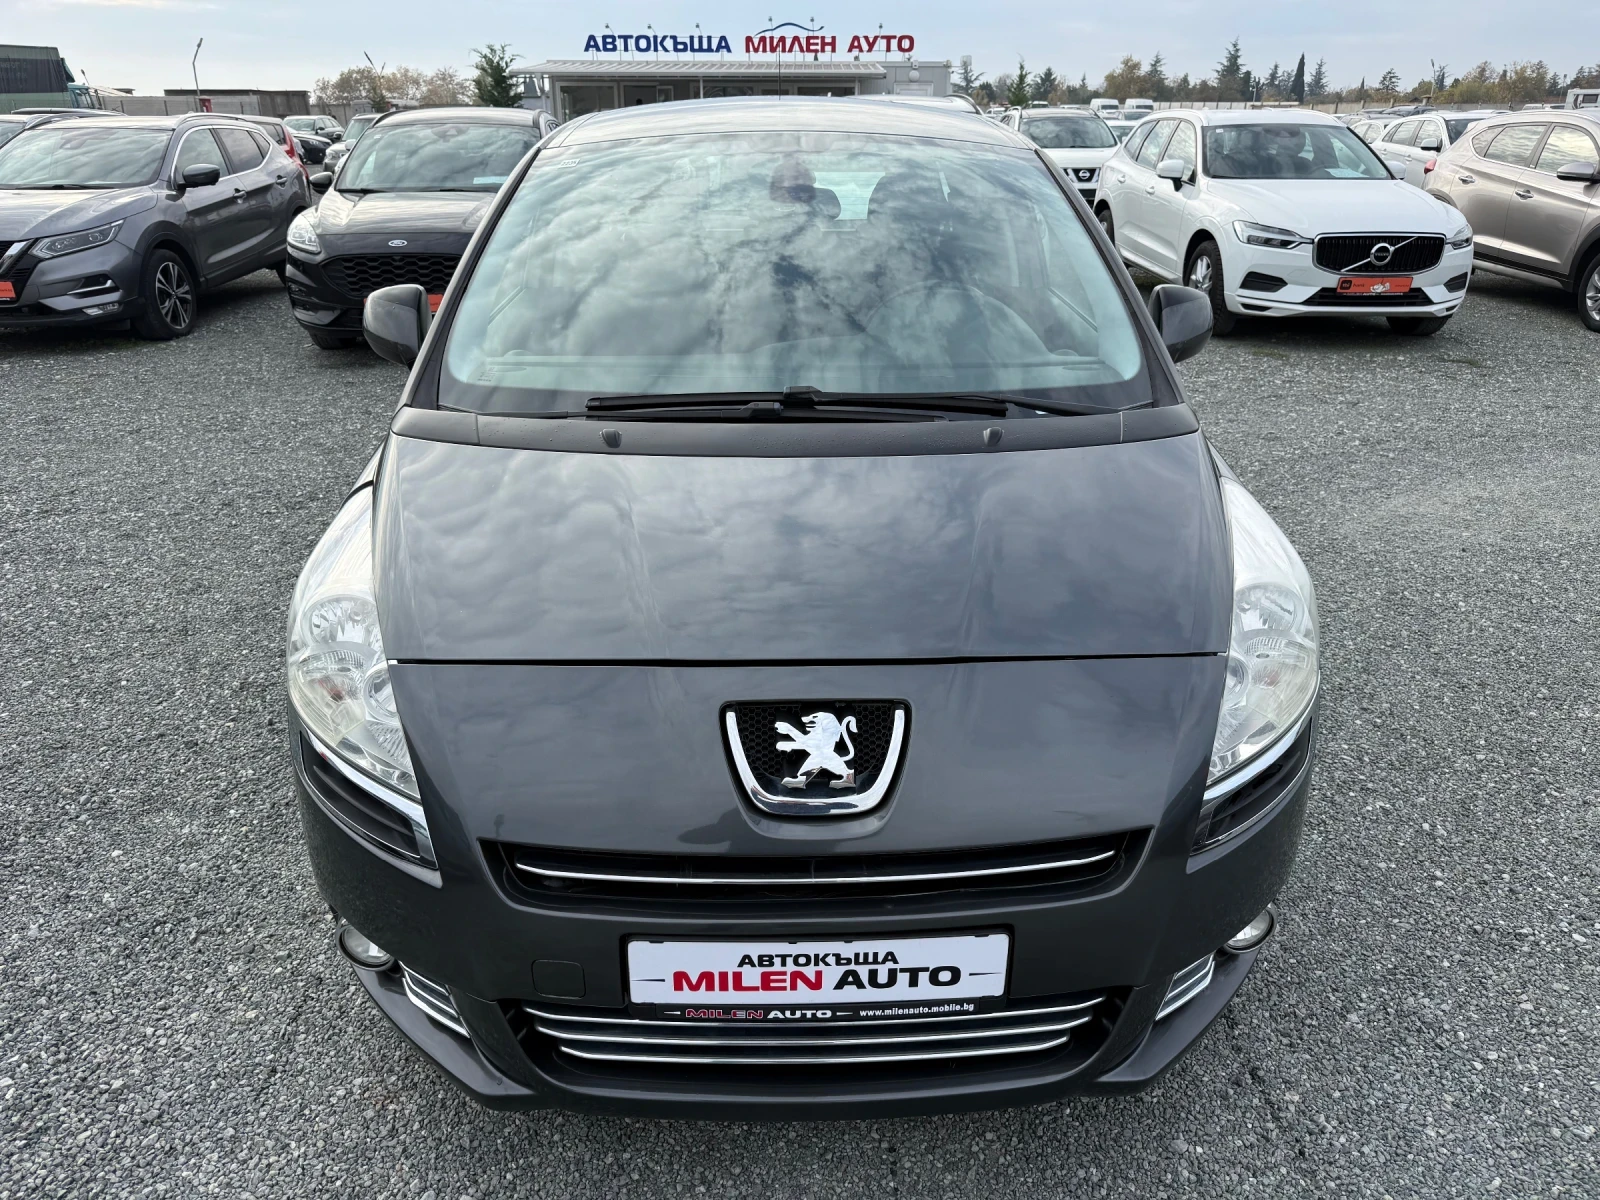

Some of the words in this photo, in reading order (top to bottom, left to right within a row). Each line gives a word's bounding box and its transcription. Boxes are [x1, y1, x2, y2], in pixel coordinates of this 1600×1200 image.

[584, 34, 732, 53] АВТОКЪЩА
[745, 35, 836, 53] МИЛЕН
[847, 35, 915, 53] АУТО
[737, 951, 899, 968] АВТОКЪЩА
[673, 970, 823, 992] MILEN
[833, 966, 961, 990] AUTO
[685, 1009, 763, 1018] MILEN
[767, 1009, 832, 1018] AUTO
[859, 1003, 974, 1017] www.milenauto.mobile.bg
